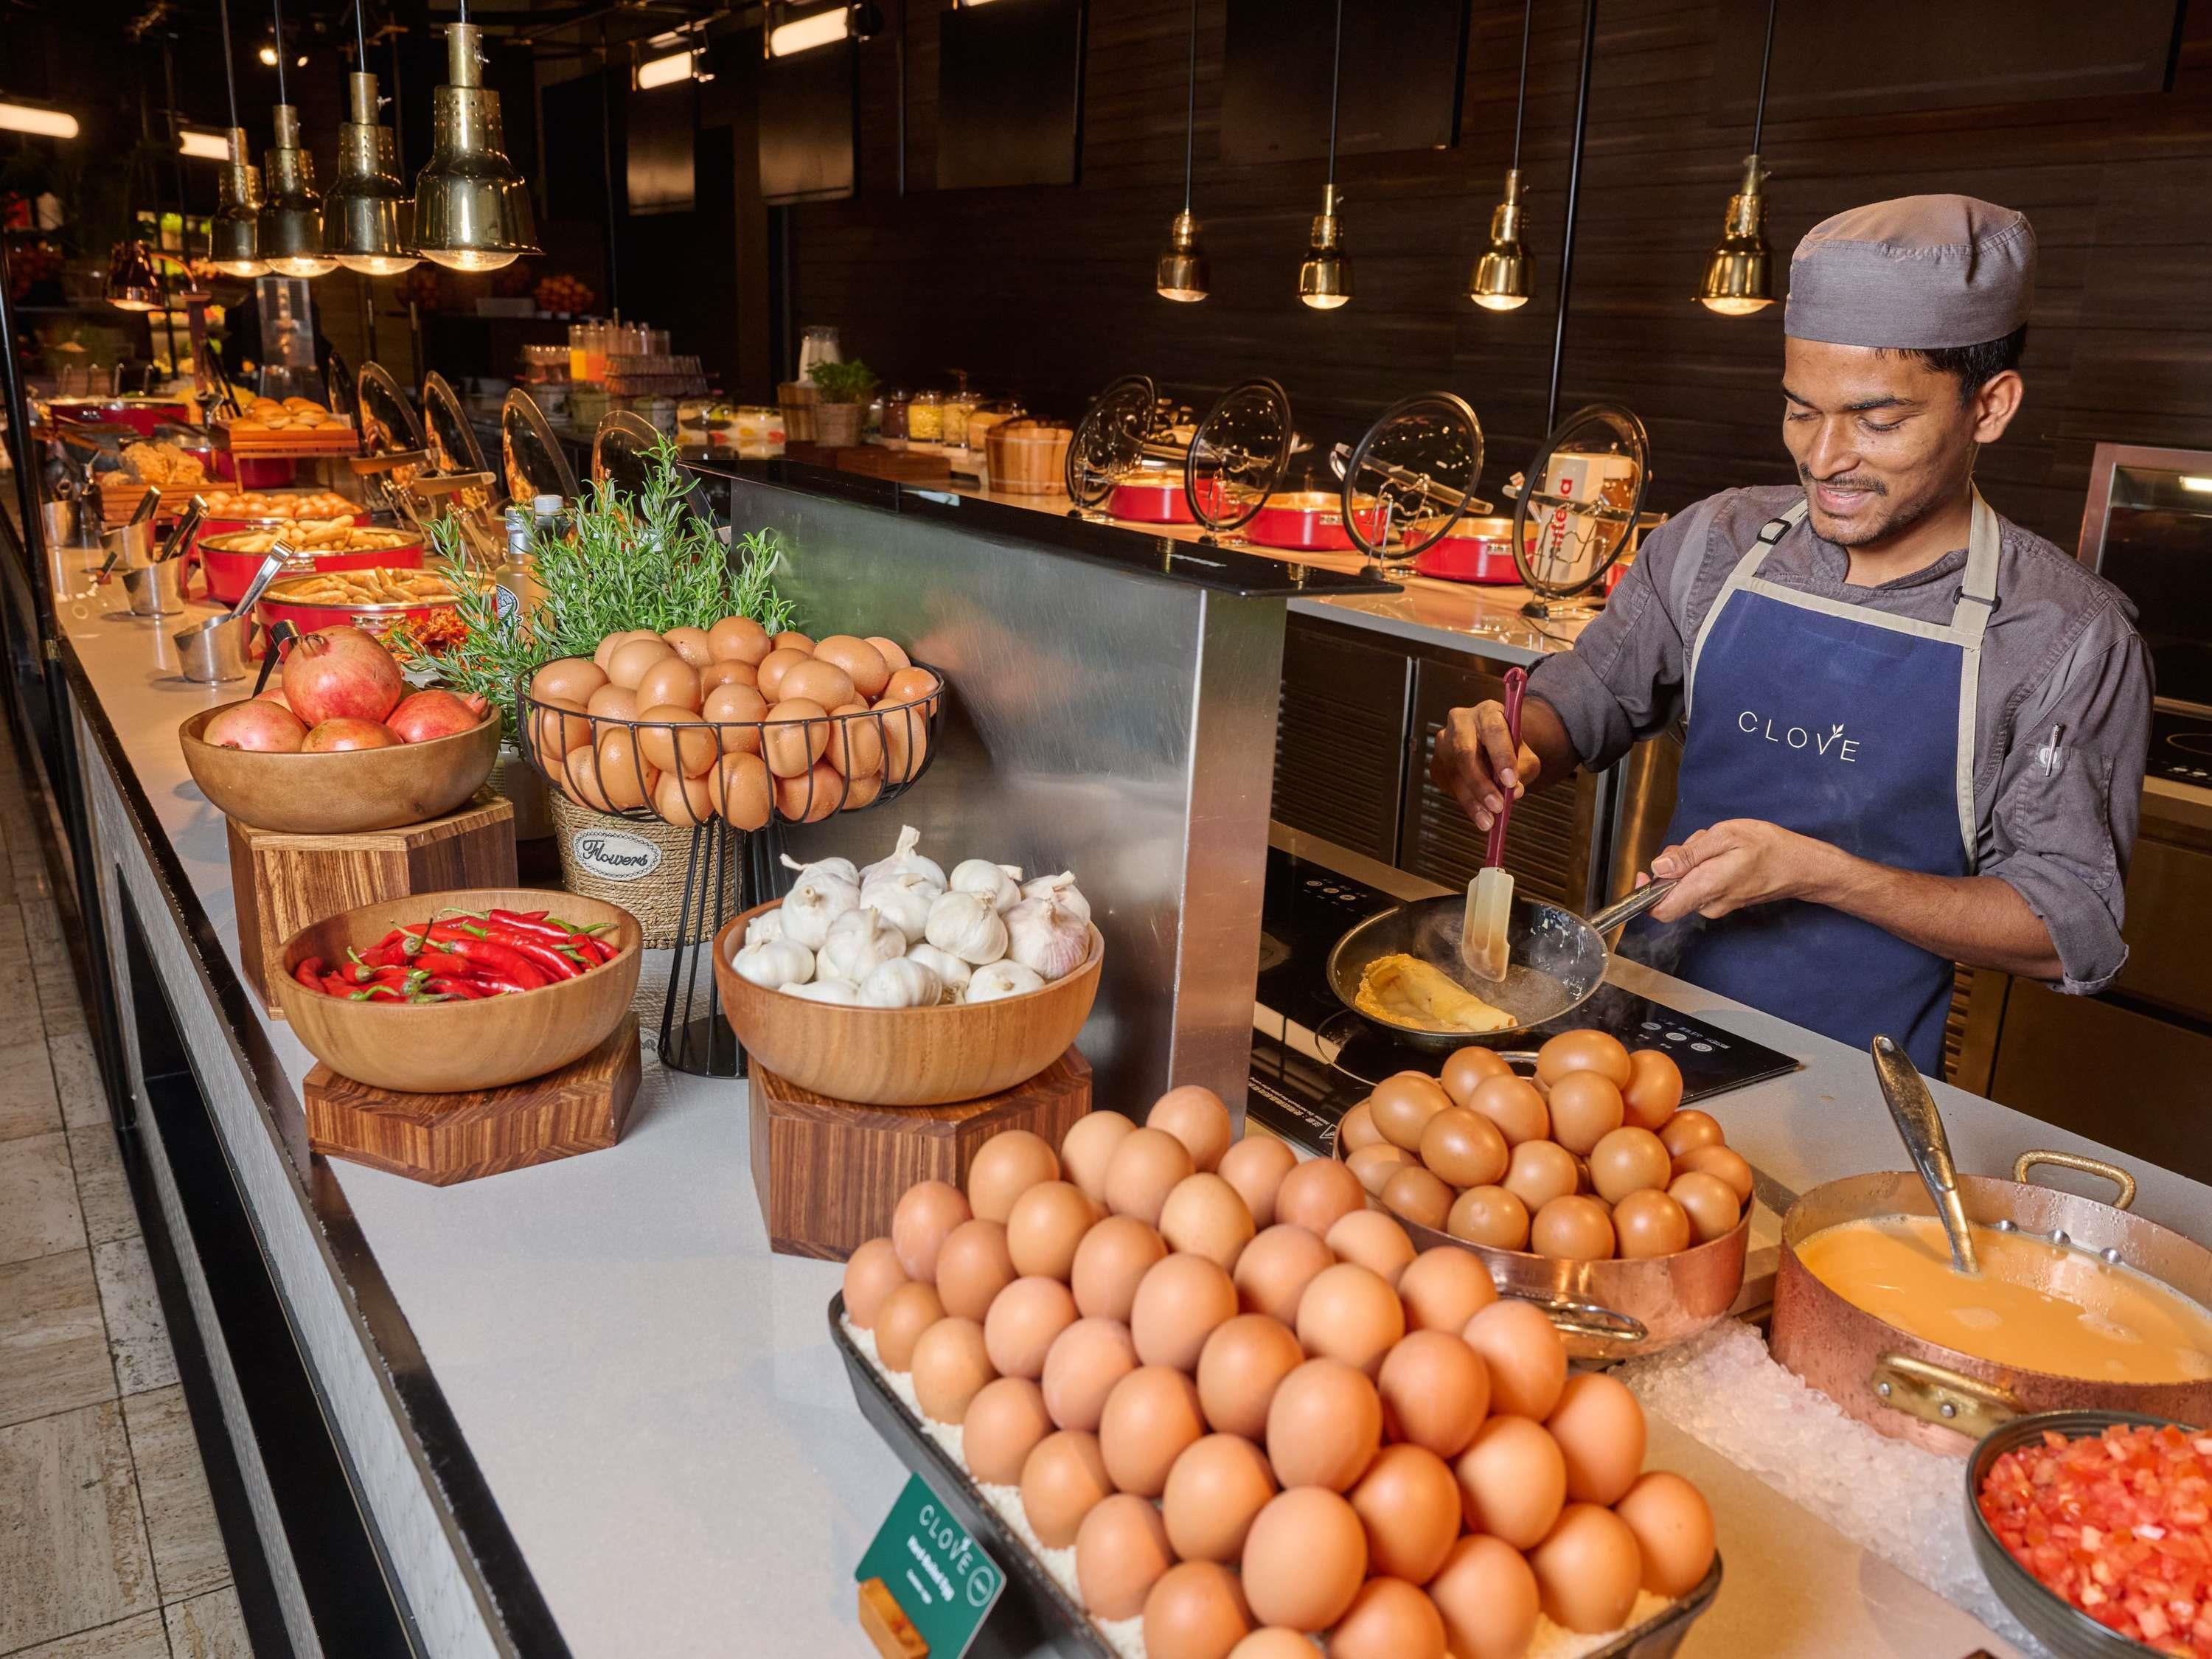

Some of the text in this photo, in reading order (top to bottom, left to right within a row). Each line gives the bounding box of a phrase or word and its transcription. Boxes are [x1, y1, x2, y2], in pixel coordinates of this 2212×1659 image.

[1550, 479, 1573, 559] nutela
[1739, 711, 1860, 762] CLOVE
[582, 839, 648, 866] Flowers
[919, 1504, 974, 1576] CLOVE
